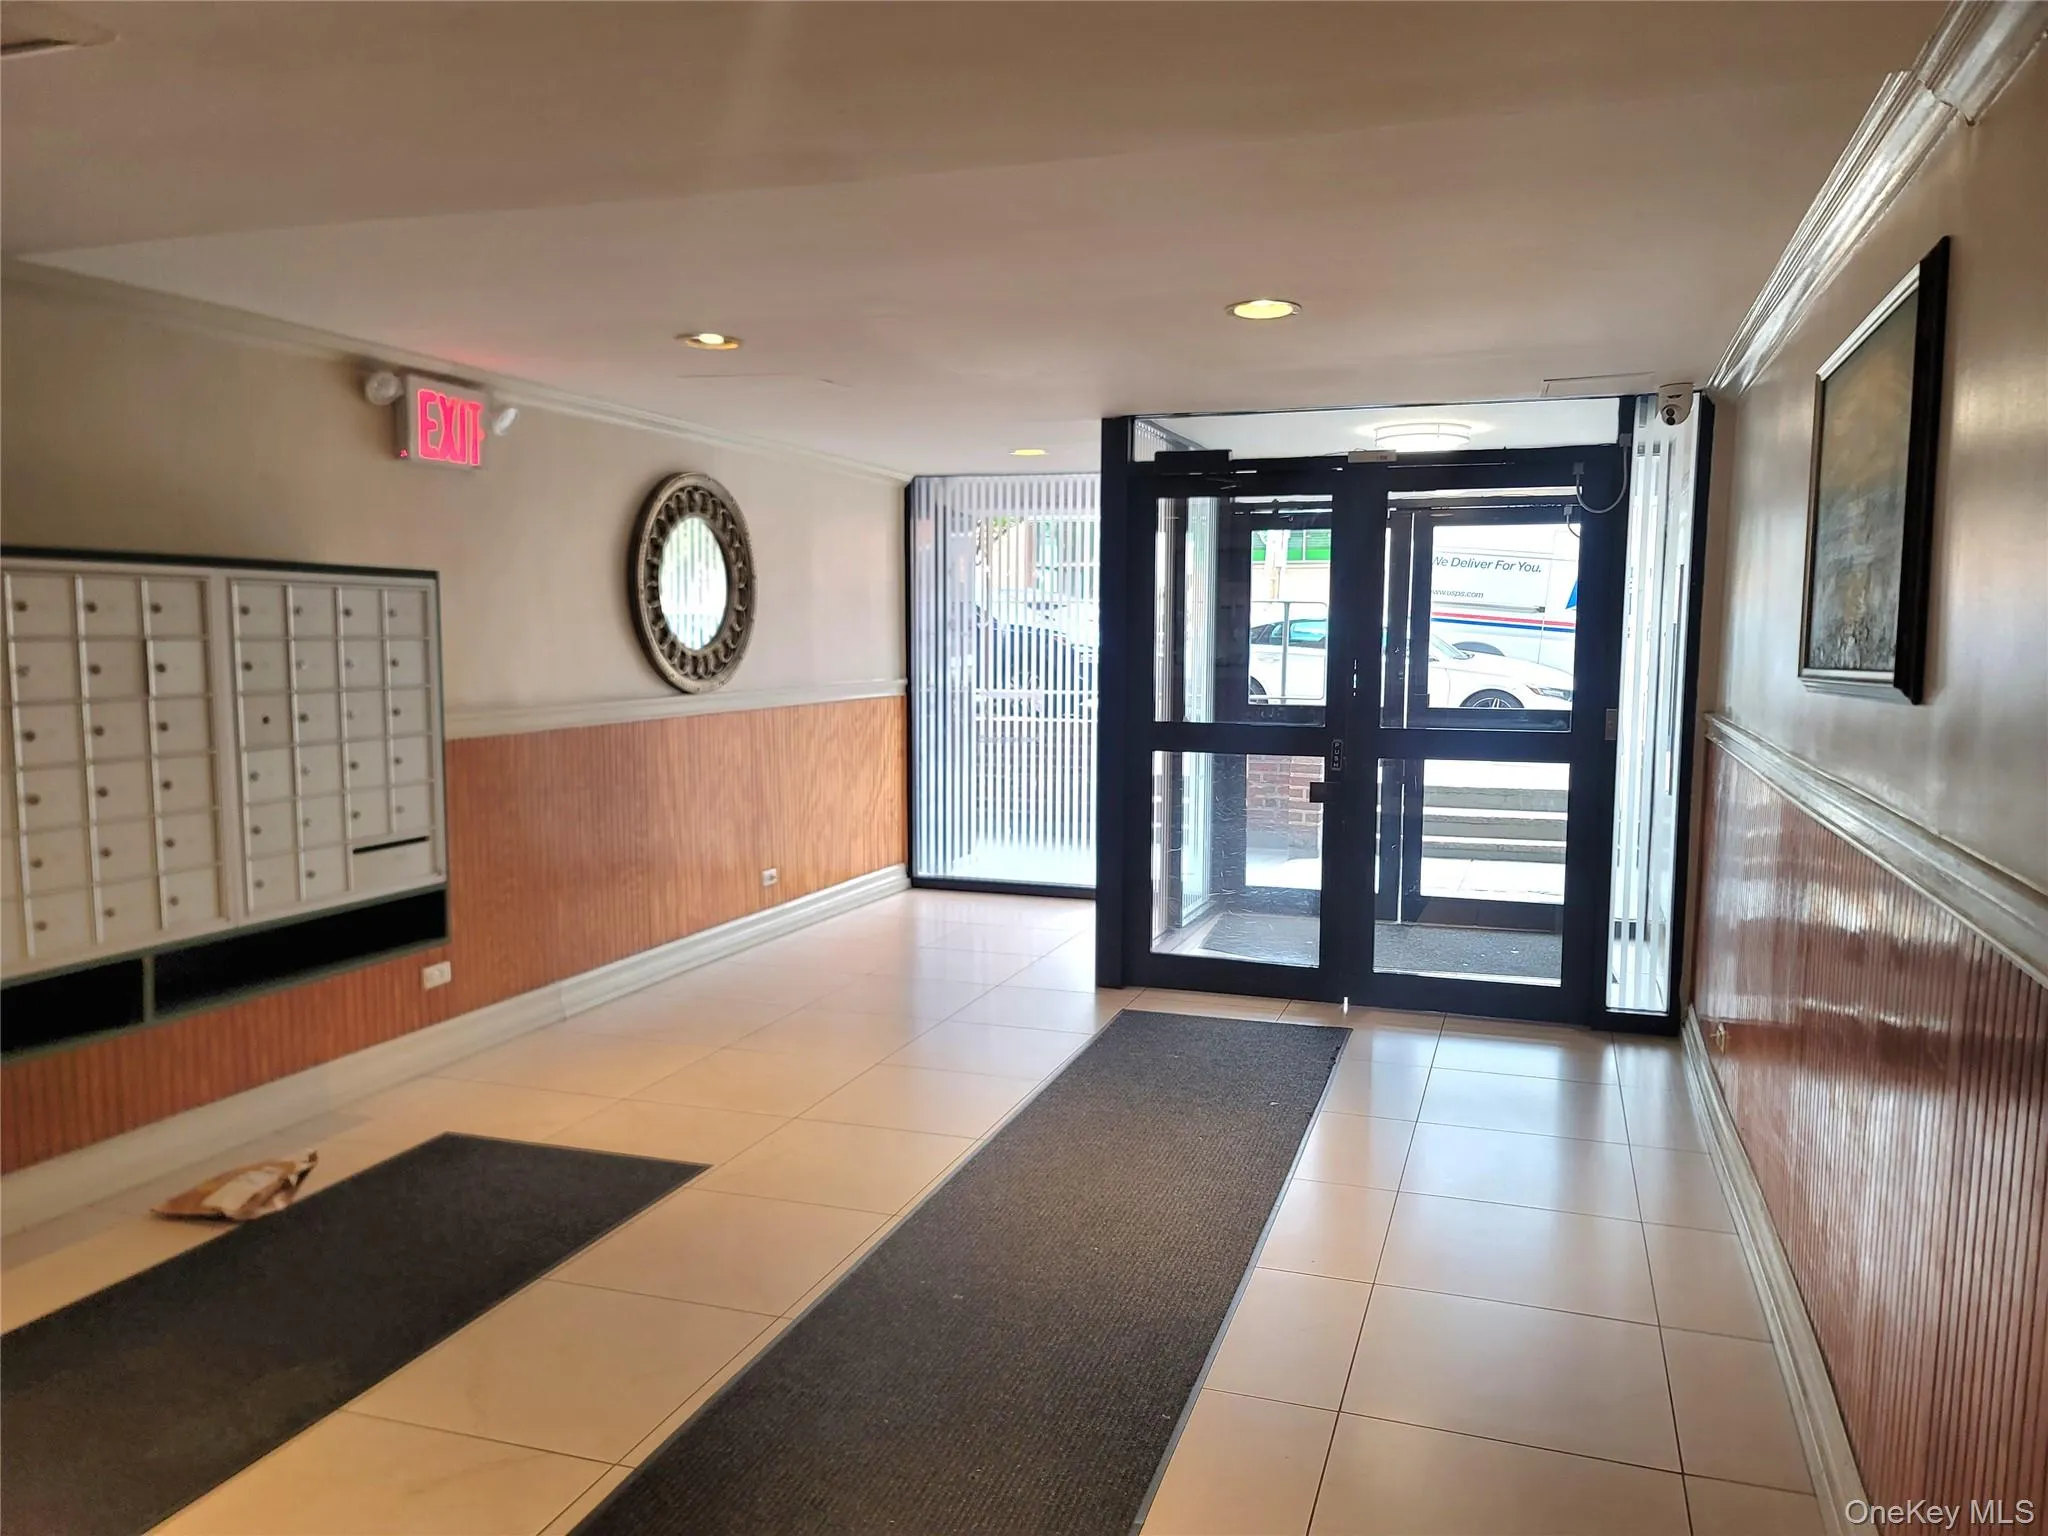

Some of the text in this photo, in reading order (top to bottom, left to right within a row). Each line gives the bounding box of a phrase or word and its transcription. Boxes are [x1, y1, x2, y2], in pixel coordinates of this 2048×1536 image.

[417, 388, 483, 466] EXIT
[1450, 557, 1493, 569] Deliver
[1494, 560, 1516, 571] For
[1517, 561, 1541, 573] You.
